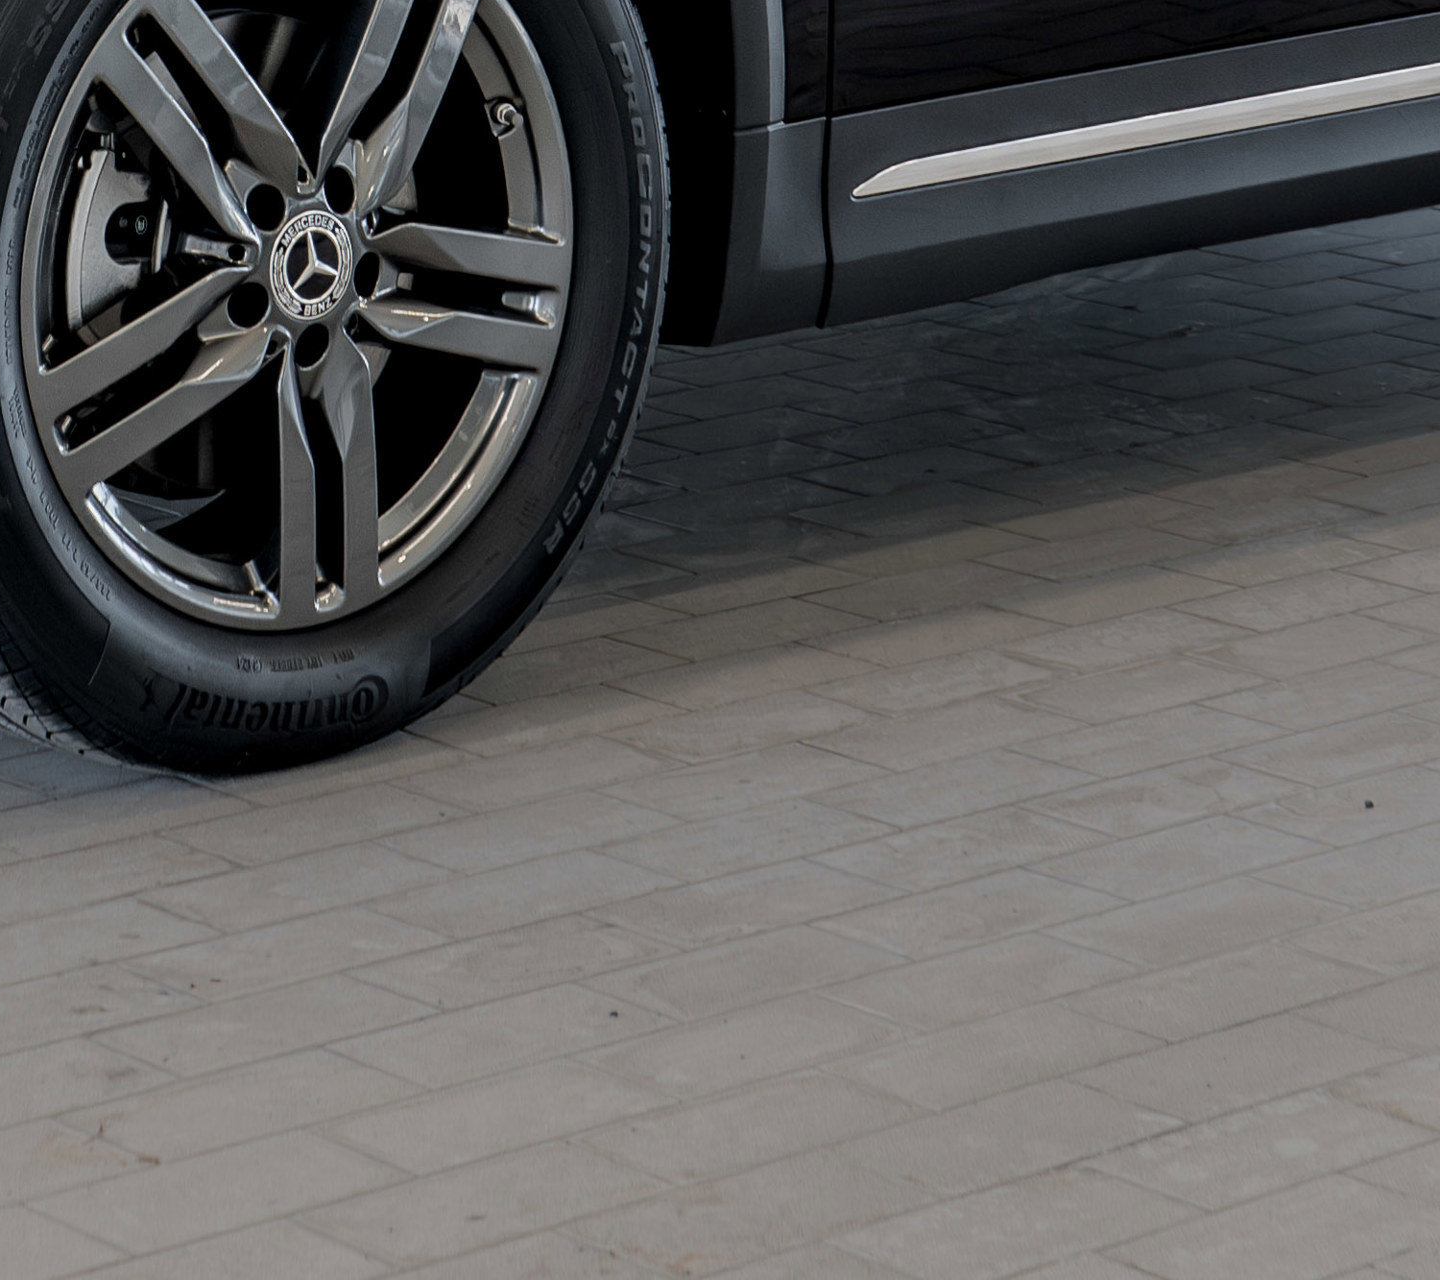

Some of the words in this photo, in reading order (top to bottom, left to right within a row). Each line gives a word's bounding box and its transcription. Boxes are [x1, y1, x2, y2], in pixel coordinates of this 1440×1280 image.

[280, 214, 335, 248] MERCEDES
[302, 296, 334, 317] BENZ
[162, 673, 391, 733] Continental
